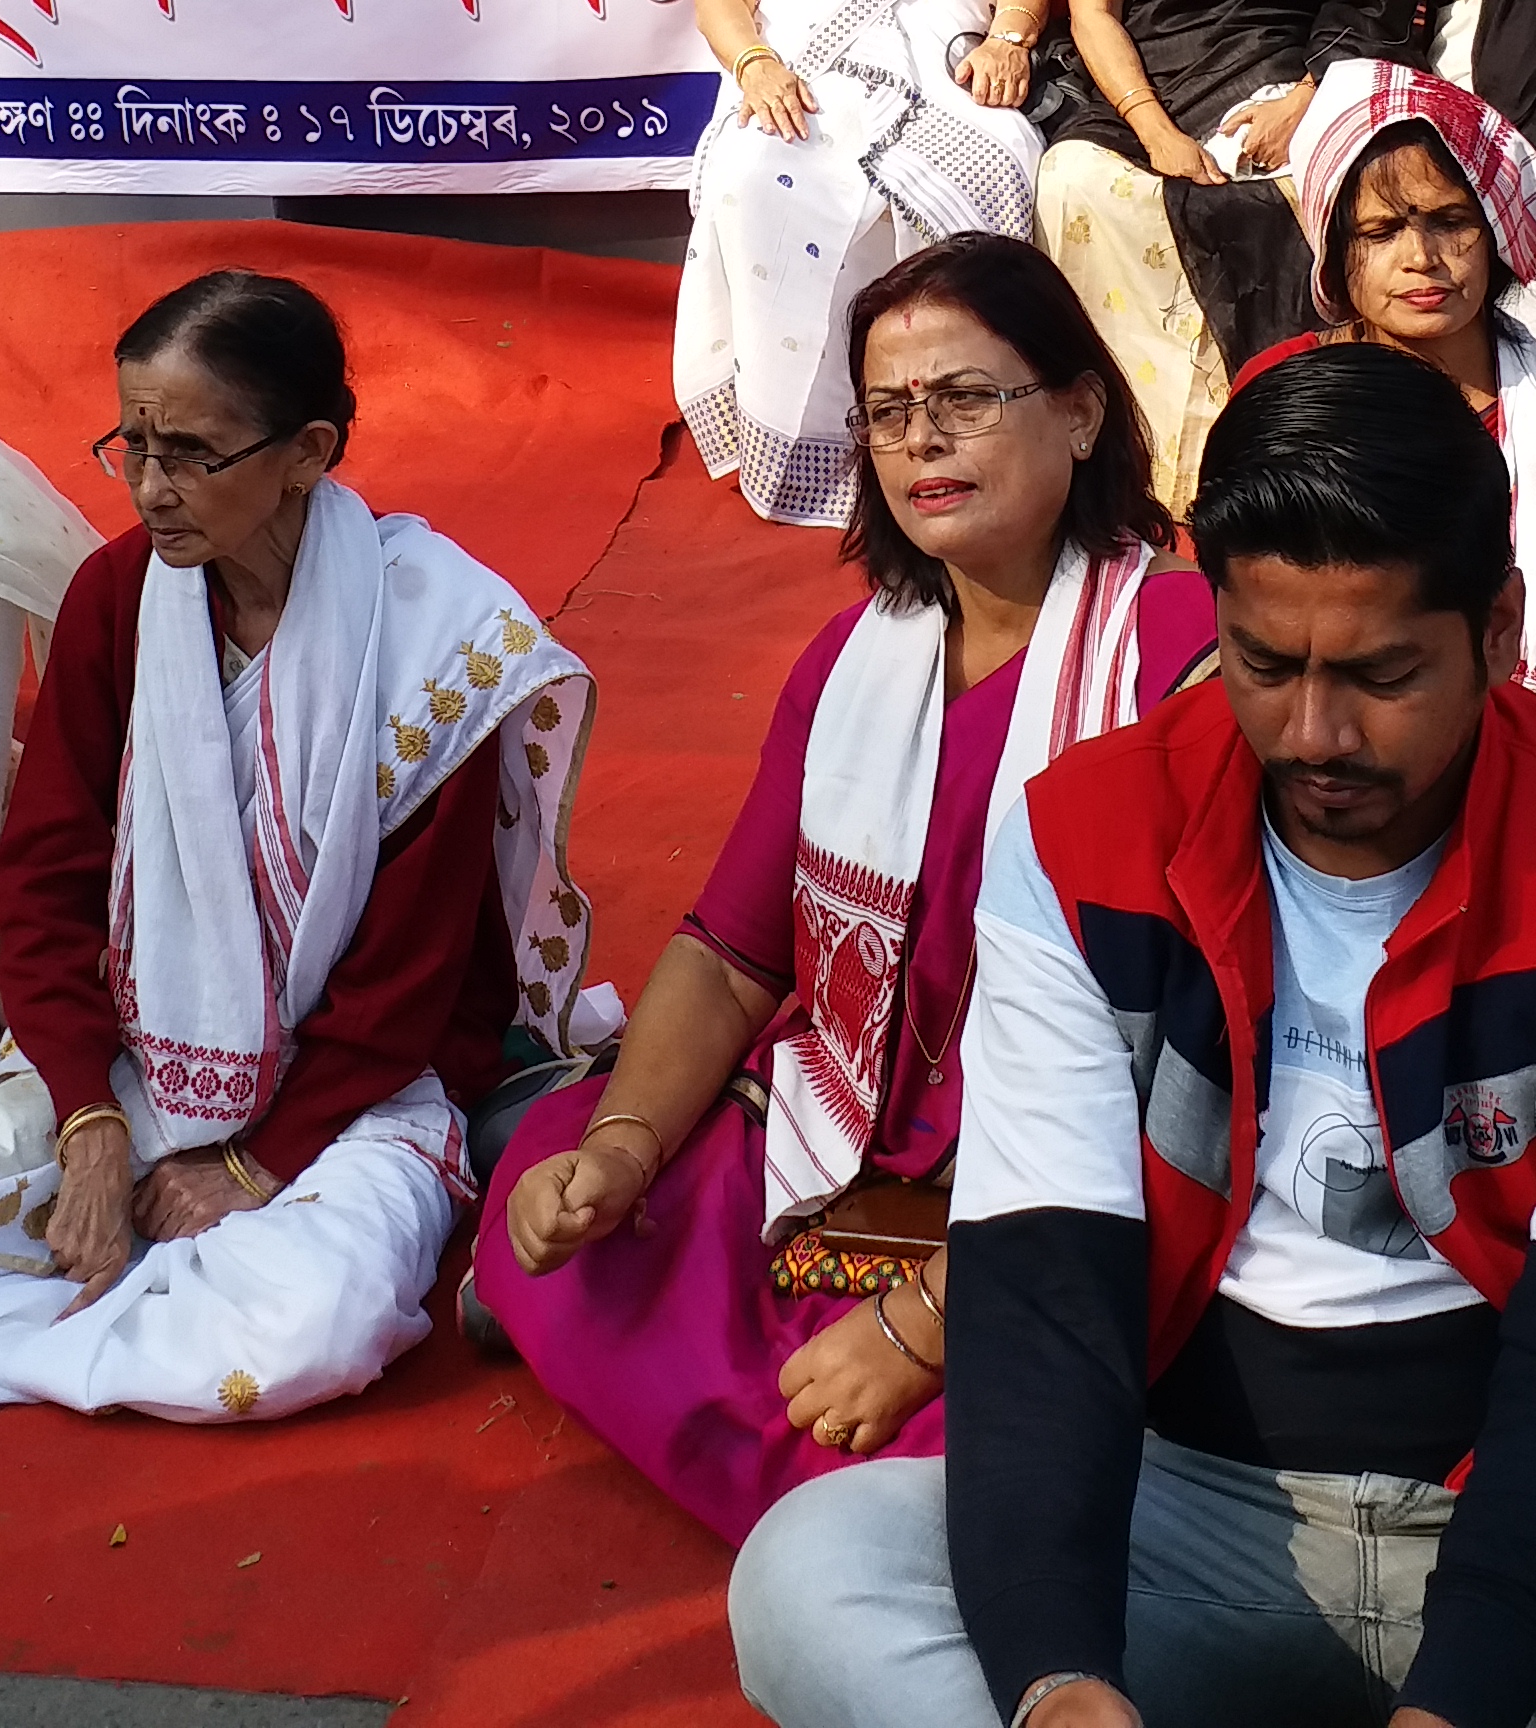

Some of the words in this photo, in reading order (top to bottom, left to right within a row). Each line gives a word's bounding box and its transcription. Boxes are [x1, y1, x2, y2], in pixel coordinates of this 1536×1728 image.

[115, 85, 247, 144] দিনাংক
[300, 105, 354, 142] ১৭
[366, 86, 531, 150] ডিচেম্বৰ,
[550, 98, 667, 143] ২০১৯
